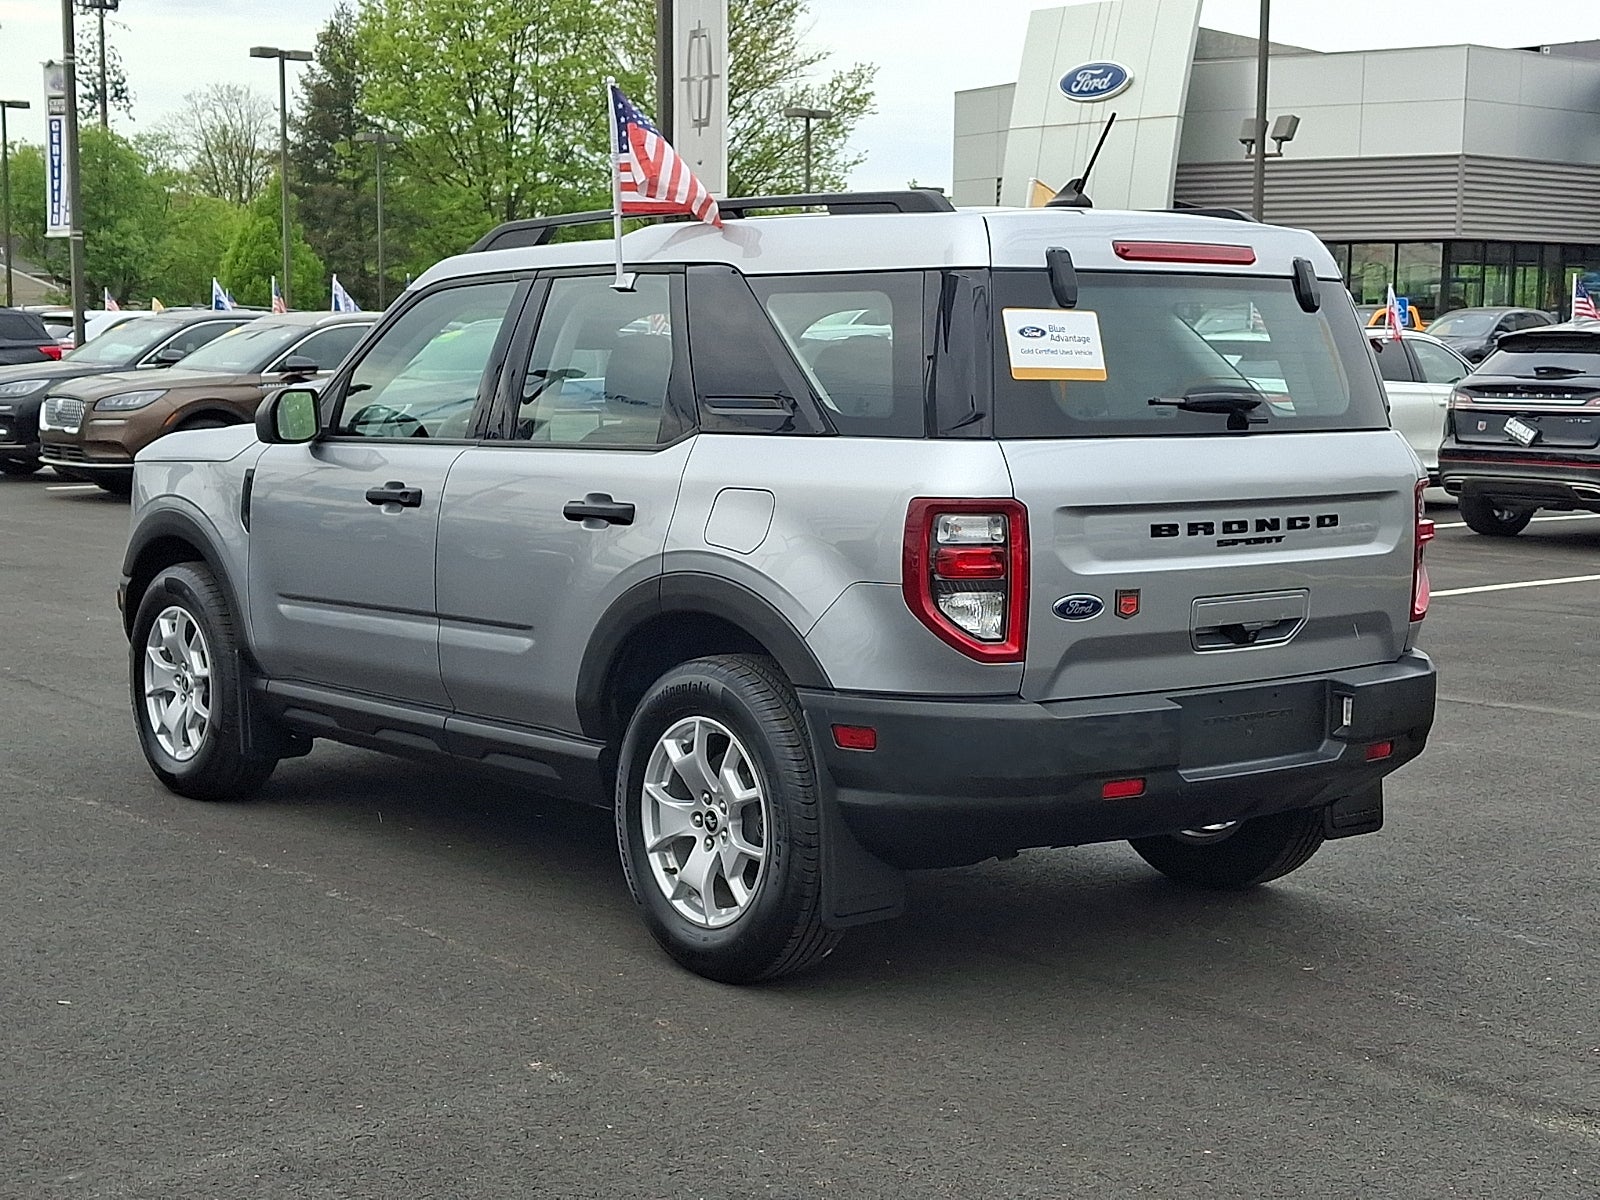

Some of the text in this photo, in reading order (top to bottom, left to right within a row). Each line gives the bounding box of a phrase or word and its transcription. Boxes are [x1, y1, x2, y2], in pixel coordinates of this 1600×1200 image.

[1070, 68, 1114, 93] Ford
[51, 120, 60, 225] CERTIFIED
[1048, 324, 1066, 333] Blue
[1050, 333, 1091, 344] Advantage
[1035, 348, 1058, 356] Certified
[1484, 391, 1572, 399] LINCOLN
[1150, 514, 1339, 538] BRONCO
[1216, 535, 1286, 547] SPORT
[1065, 600, 1094, 615] Ford
